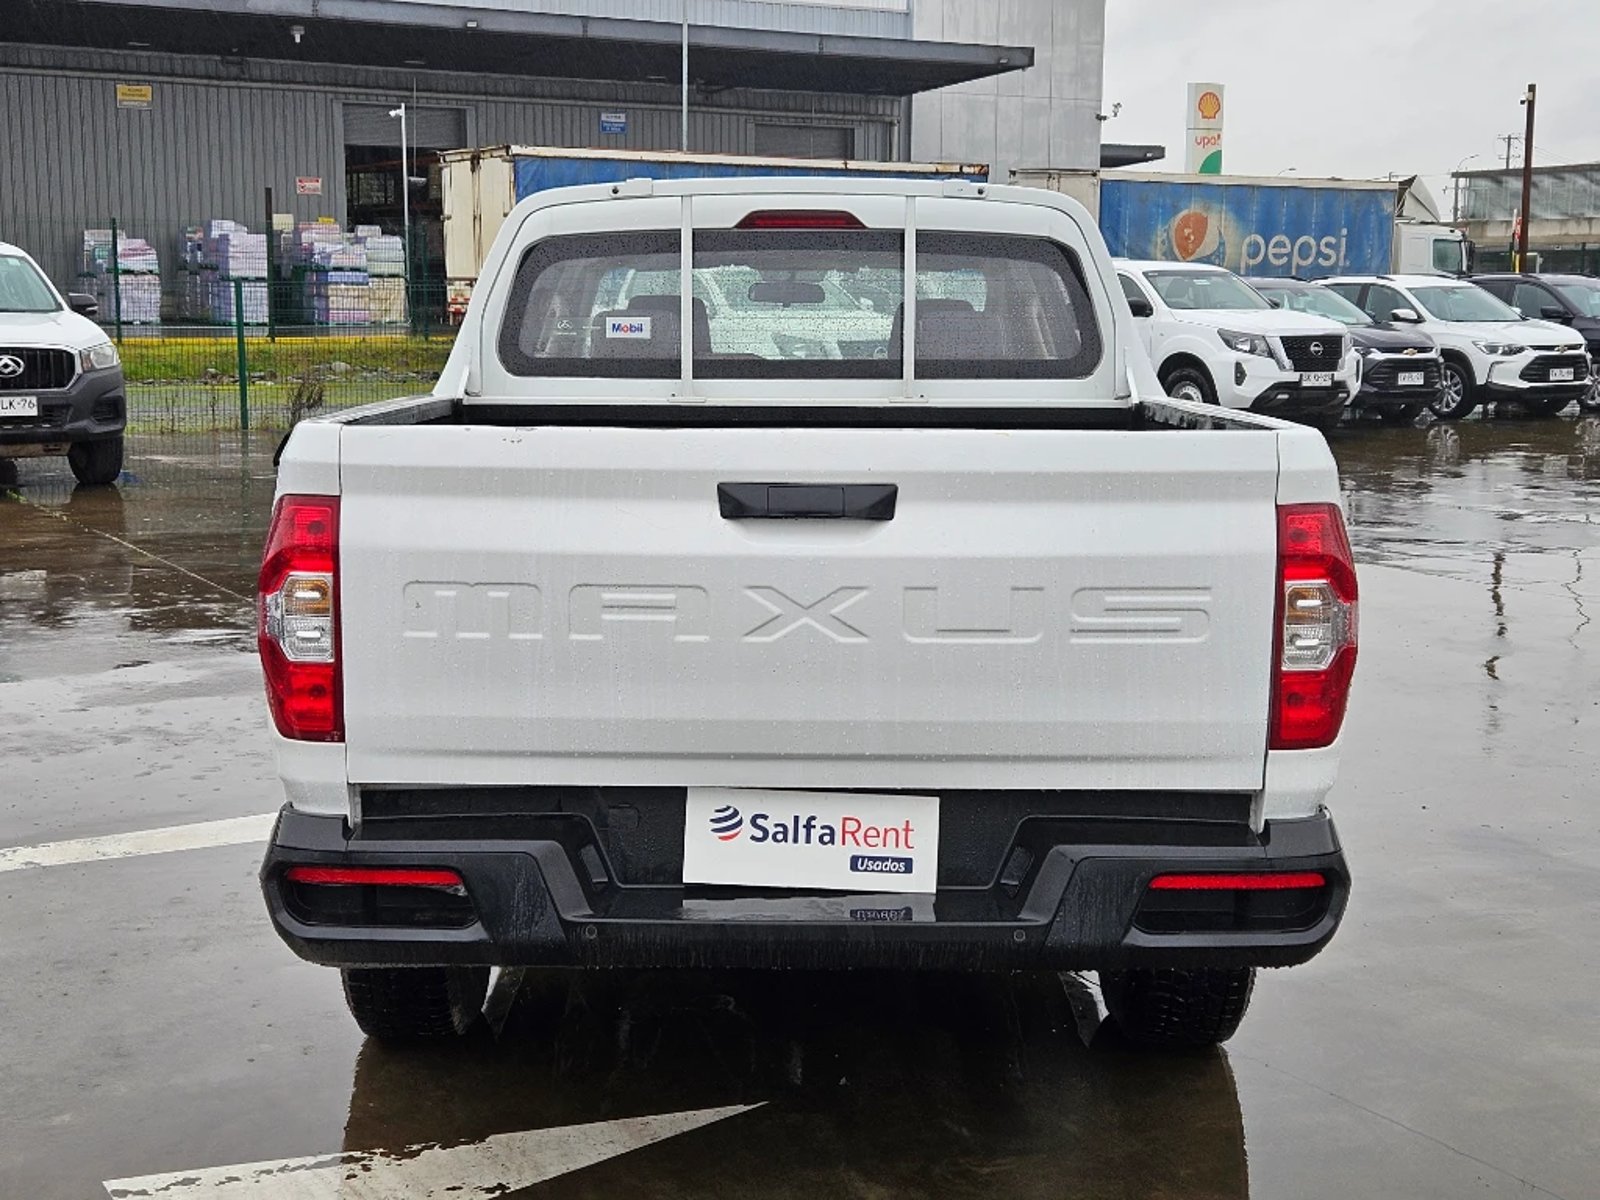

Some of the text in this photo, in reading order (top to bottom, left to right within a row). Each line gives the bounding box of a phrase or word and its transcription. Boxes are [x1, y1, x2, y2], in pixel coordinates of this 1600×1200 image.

[1241, 228, 1348, 275] pepsi
[612, 323, 643, 333] Mobil
[403, 581, 1212, 644] MAXUS
[857, 857, 906, 872] Usados
